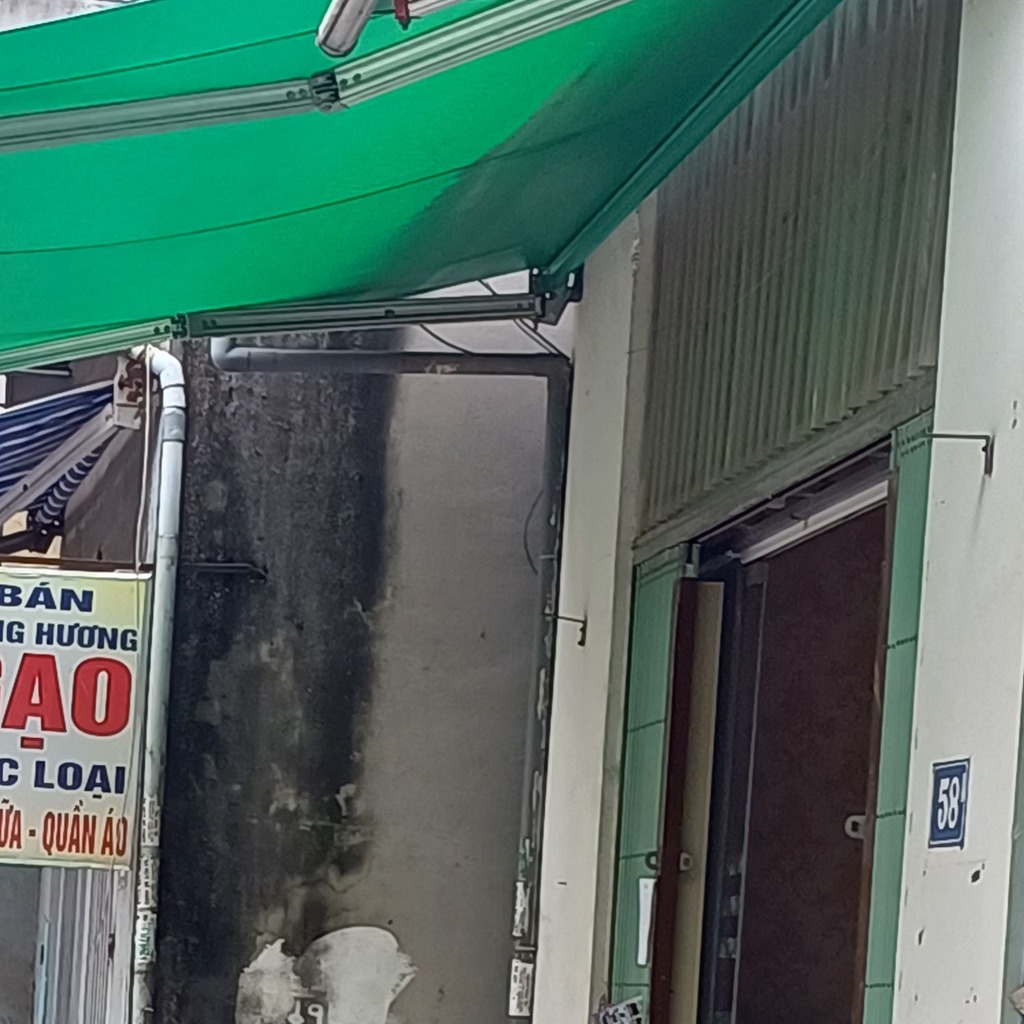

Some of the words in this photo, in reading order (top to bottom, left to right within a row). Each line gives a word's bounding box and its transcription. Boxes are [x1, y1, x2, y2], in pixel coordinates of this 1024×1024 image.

[35, 622, 138, 651] HƯƠNG
[34, 760, 126, 799] LOẠI
[937, 776, 961, 830] 58
[42, 800, 96, 857] QUẦN
[101, 807, 128, 857] ÁO
